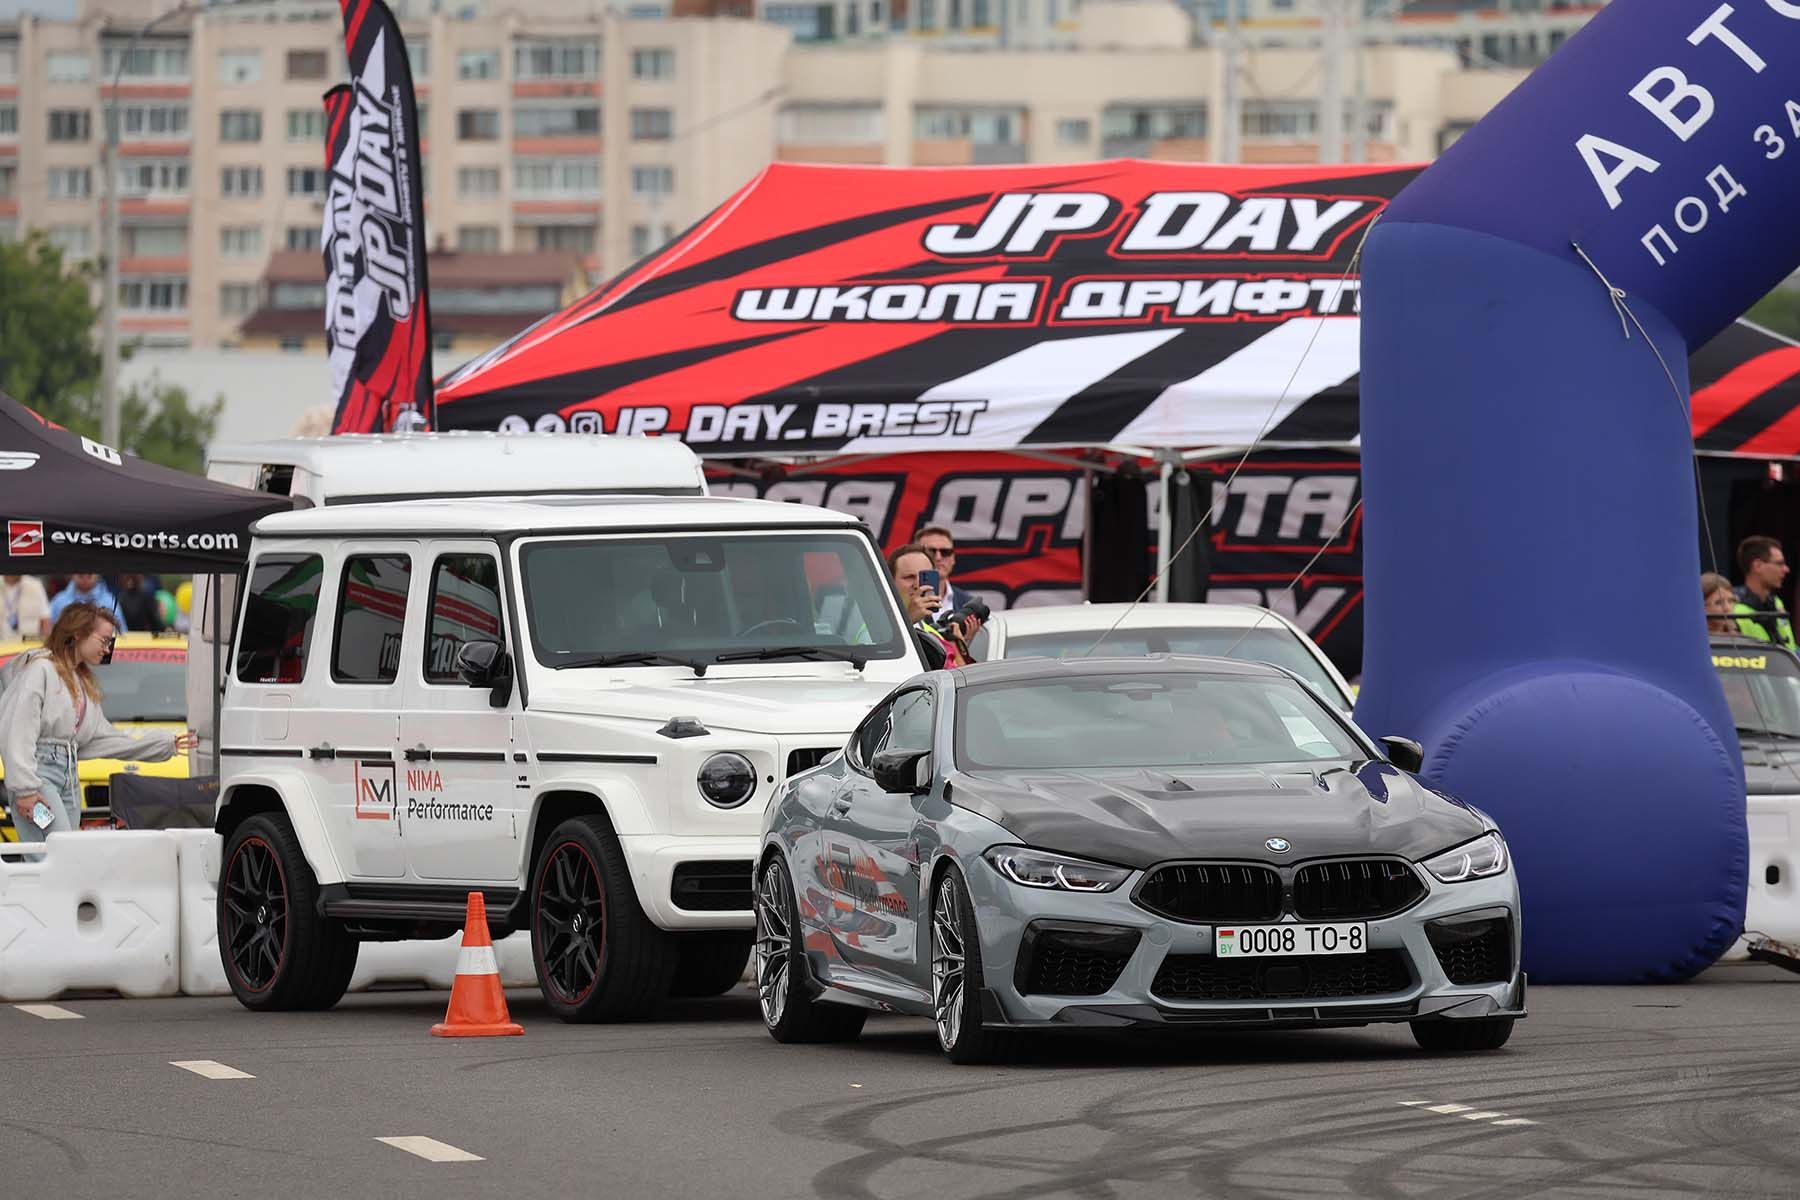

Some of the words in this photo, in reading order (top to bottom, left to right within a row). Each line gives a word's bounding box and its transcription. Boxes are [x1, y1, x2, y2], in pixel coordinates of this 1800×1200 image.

[1575, 0, 1800, 210] АВТ
[356, 86, 401, 217] DAY
[924, 192, 1110, 254] JP
[1121, 192, 1364, 252] DAY
[1641, 163, 1748, 267] ПОД
[735, 282, 1038, 321] ШКОЛА
[1061, 278, 1361, 318] ДРИФТ
[51, 530, 239, 550] evs-sports.com
[407, 769, 443, 793] NIMA
[407, 797, 494, 821] Performance
[1220, 943, 1234, 954] BY
[1239, 927, 1296, 954] 0008
[1304, 925, 1362, 952] TO-8
